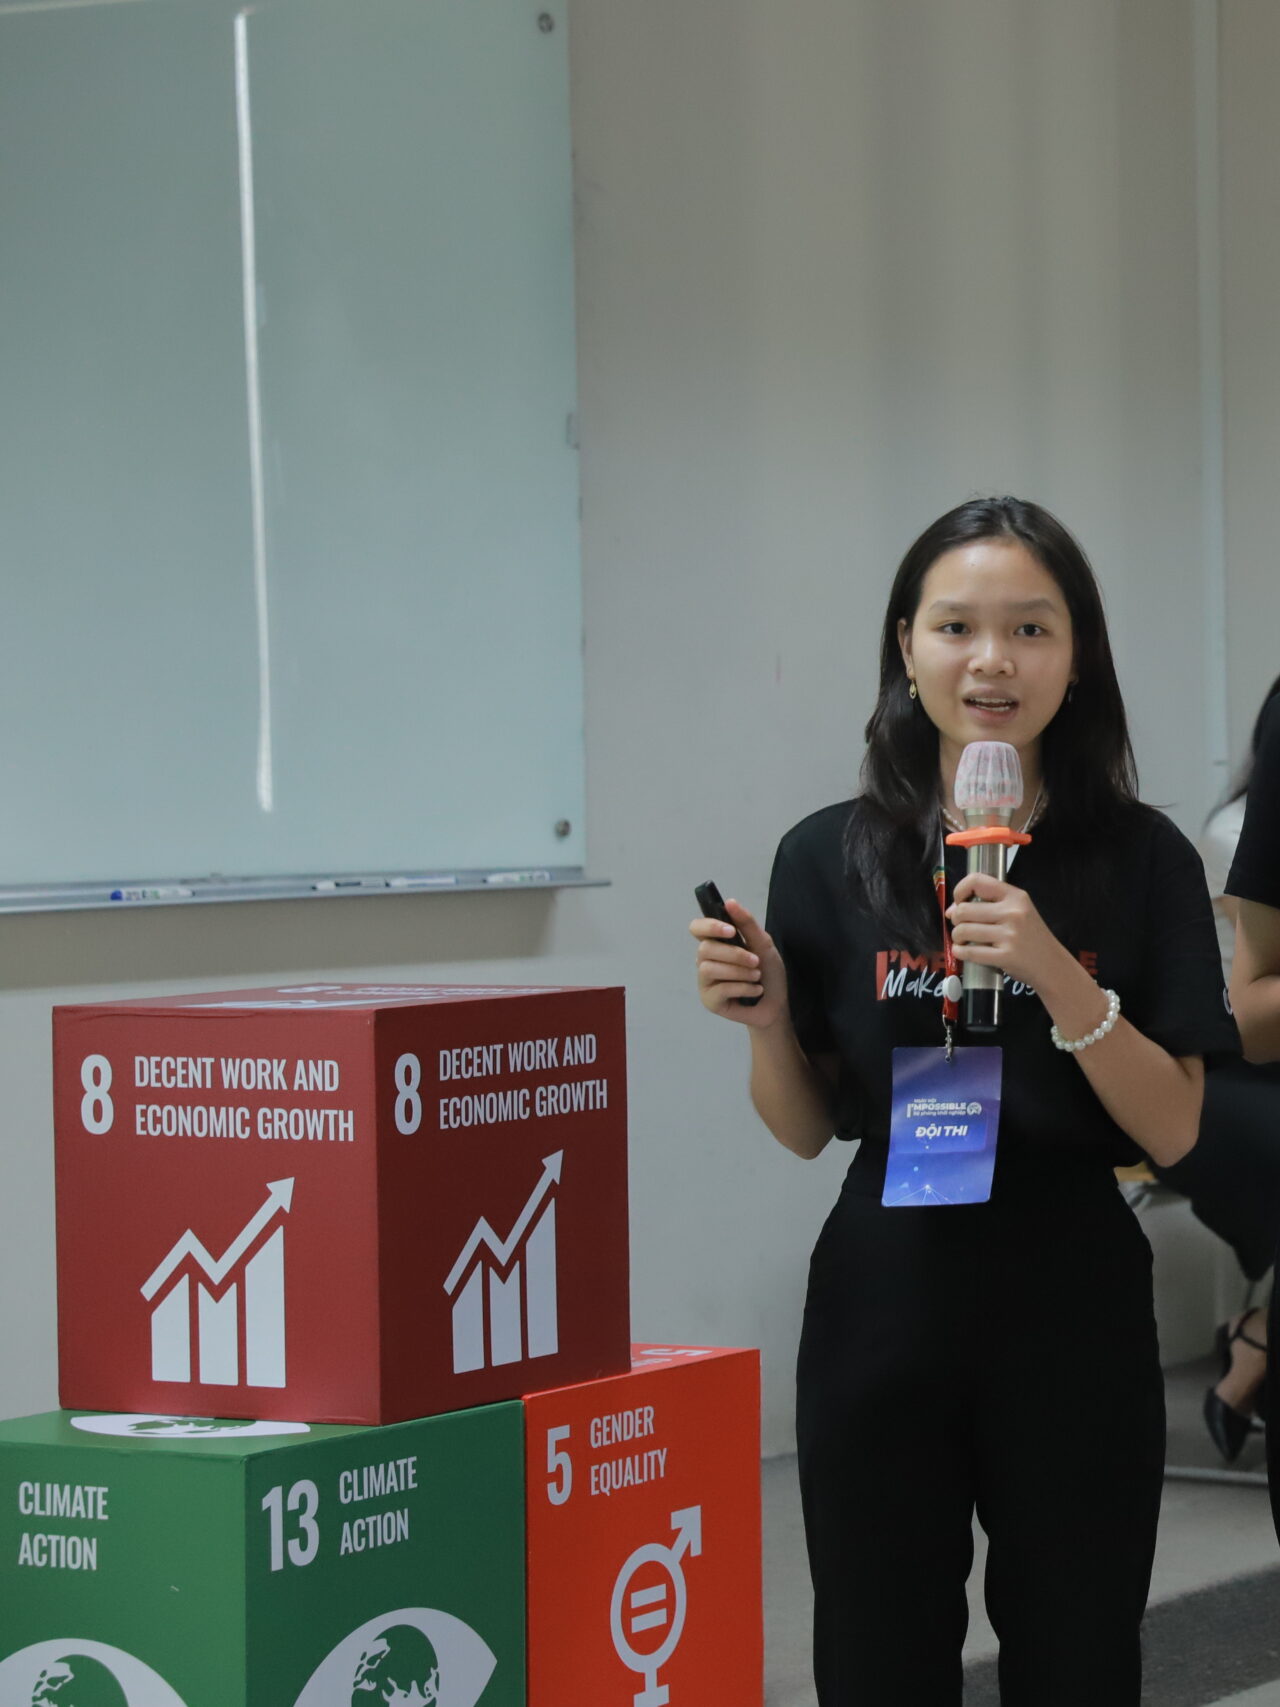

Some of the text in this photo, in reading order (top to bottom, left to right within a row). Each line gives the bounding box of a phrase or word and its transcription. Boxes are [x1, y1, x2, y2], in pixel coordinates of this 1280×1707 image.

[134, 1056, 339, 1092] DECENT WORK AND
[439, 1033, 597, 1081] DECENT WORK AND
[80, 1054, 114, 1135] 8
[394, 1052, 422, 1135] 8
[439, 1079, 608, 1130] ECONOMIC GROWTH
[135, 1104, 354, 1142] ECONOMIC GROWTH
[915, 1122, 969, 1140] ĐỘI THI
[590, 1405, 655, 1448] GENDER
[339, 1455, 418, 1505] CLIMATE
[547, 1424, 573, 1506] 5
[590, 1447, 667, 1497] EQUALITY
[18, 1481, 109, 1521] CLIMATE
[261, 1478, 320, 1573] 13
[18, 1532, 98, 1571] ACTION
[339, 1507, 409, 1557] ACTION
